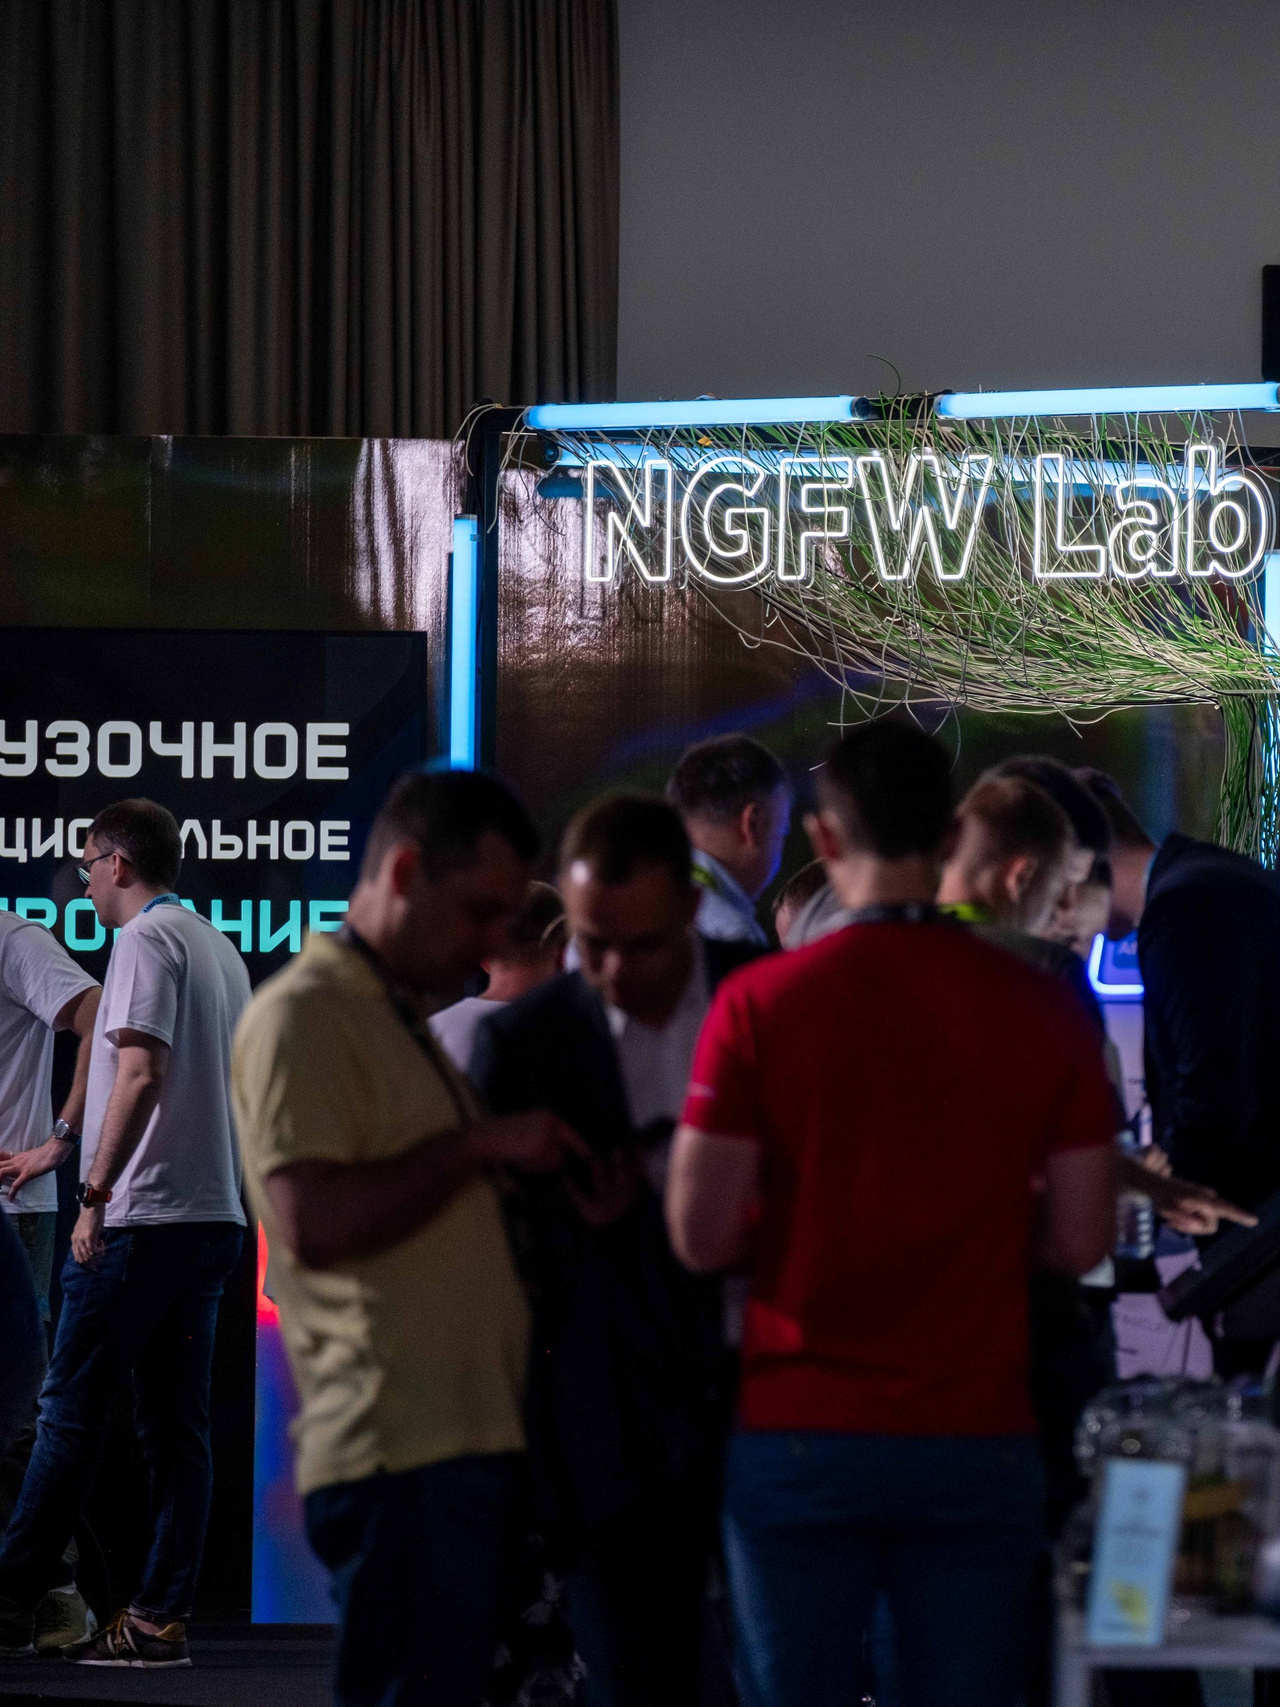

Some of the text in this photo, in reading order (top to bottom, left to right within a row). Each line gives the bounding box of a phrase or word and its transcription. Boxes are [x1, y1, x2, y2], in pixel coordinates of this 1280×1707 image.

[585, 444, 1268, 583] NGFW Lab
[0, 719, 350, 780] УЗОЧНОЕ
[0, 817, 351, 863] ЦИОЛЬНОЕ
